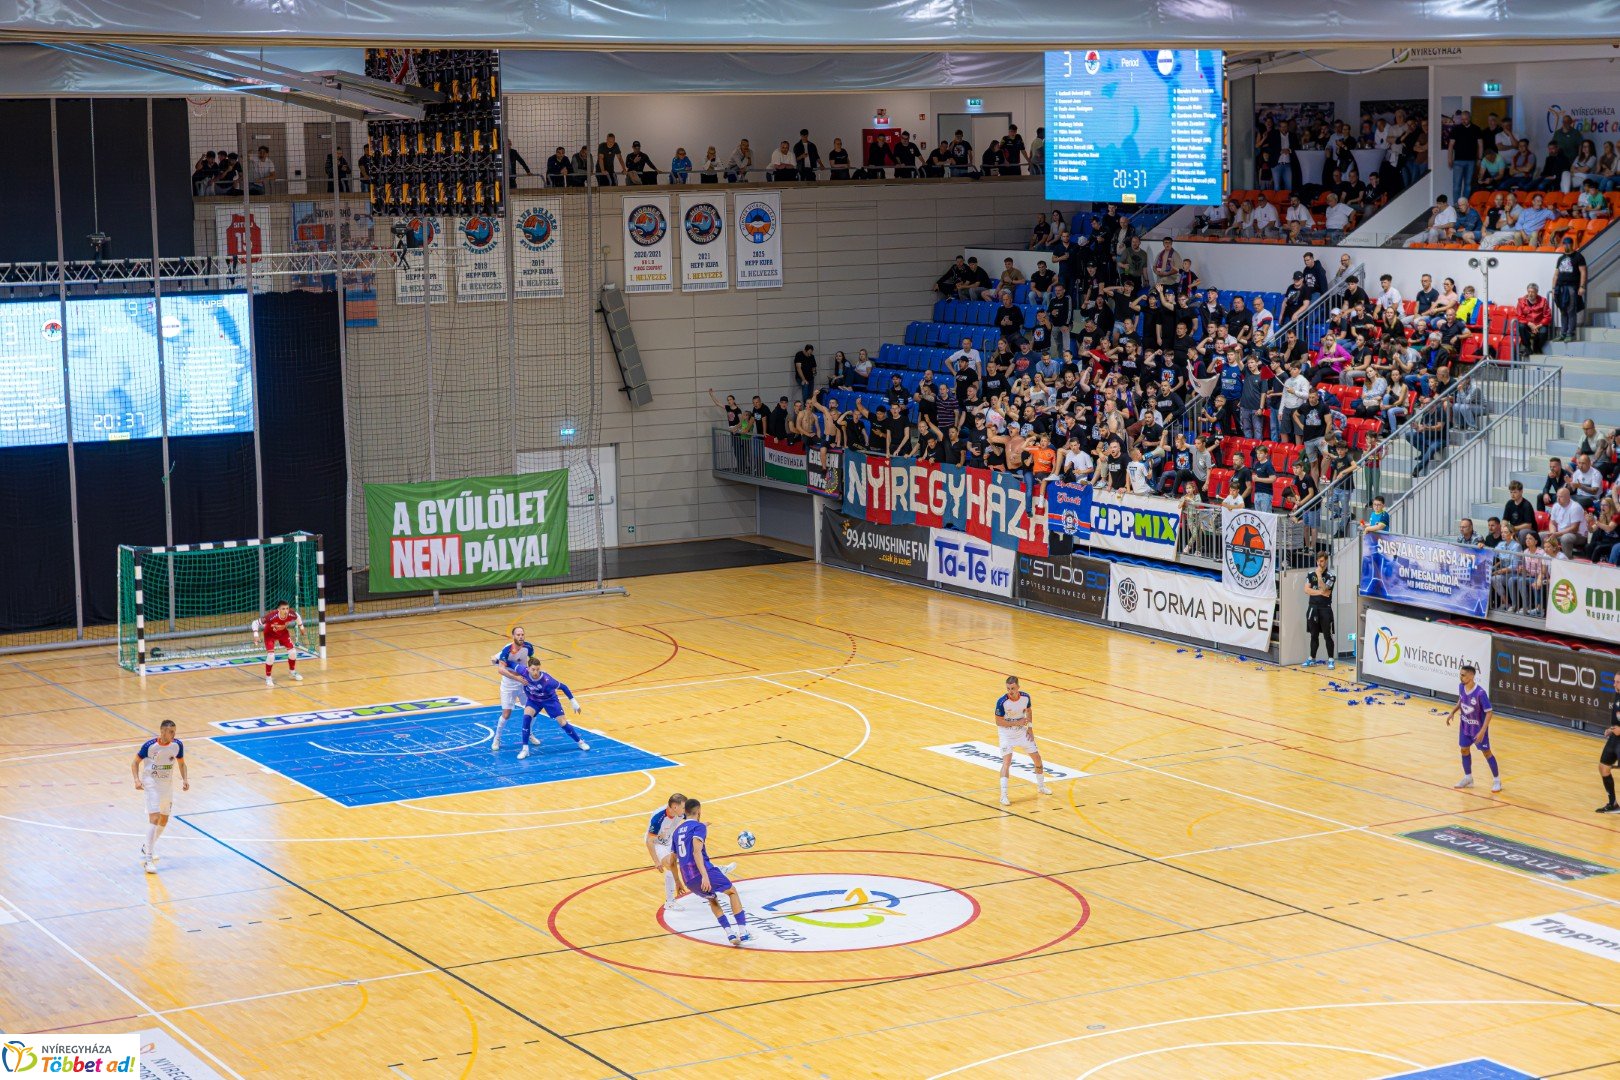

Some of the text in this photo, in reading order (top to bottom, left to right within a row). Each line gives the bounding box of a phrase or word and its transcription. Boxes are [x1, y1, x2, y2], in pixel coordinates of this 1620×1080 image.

[1121, 58, 1139, 67] Period
[1113, 169, 1147, 189] 20:37
[93, 413, 145, 430] 20:37
[392, 488, 549, 536] A GYŰLÖLET
[845, 459, 1050, 544] NYÍREGYHÁZA
[1230, 515, 1266, 539] FUTSAL
[391, 533, 549, 579] NEM PÁLYA!
[846, 528, 930, 563] 99.4 SUNSHINE FM
[1415, 542, 1427, 560] ÉS
[1428, 544, 1458, 565] TÁRSA
[1459, 553, 1478, 570] KFT.
[934, 539, 1009, 588] Ta-Te KFT
[1399, 565, 1411, 577] ÖN
[1143, 588, 1269, 632] TORMA PINCE
[1585, 609, 1614, 621] Magyar
[1498, 679, 1600, 707] ÉPÍTÉSZTERVEZŐ
[677, 833, 687, 858] 5
